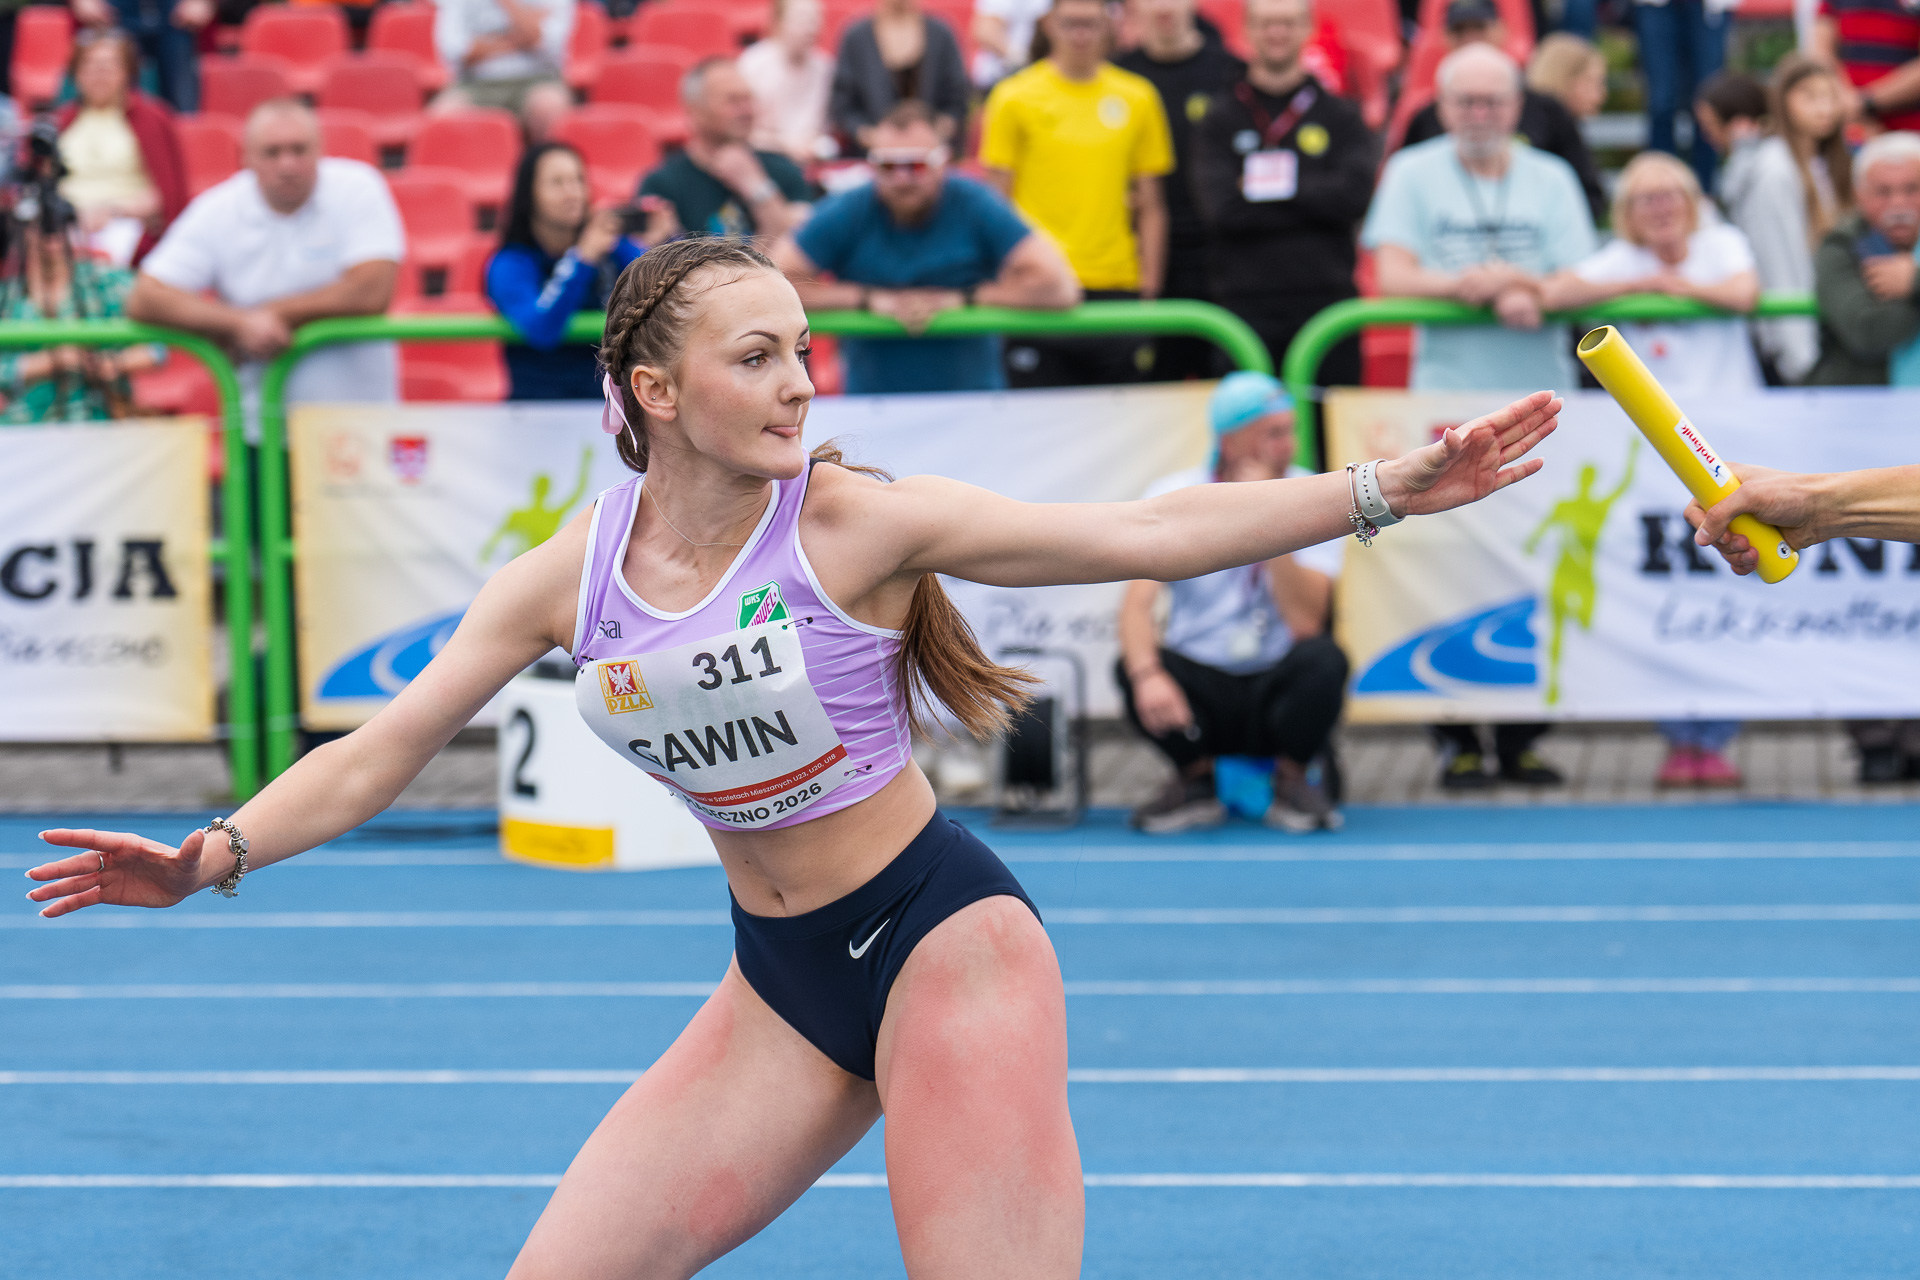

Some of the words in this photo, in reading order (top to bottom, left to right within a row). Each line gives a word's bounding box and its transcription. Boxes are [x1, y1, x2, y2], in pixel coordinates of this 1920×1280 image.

[1682, 425, 1716, 464] polanik
[744, 593, 761, 606] WKS
[692, 636, 782, 690] 311
[608, 694, 651, 713] PZLA
[508, 707, 540, 799] 2
[750, 777, 793, 797] Mieszanych
[793, 771, 809, 782] U23,
[808, 762, 824, 774] U20,
[824, 753, 837, 764] U18
[773, 782, 822, 814] 2026
